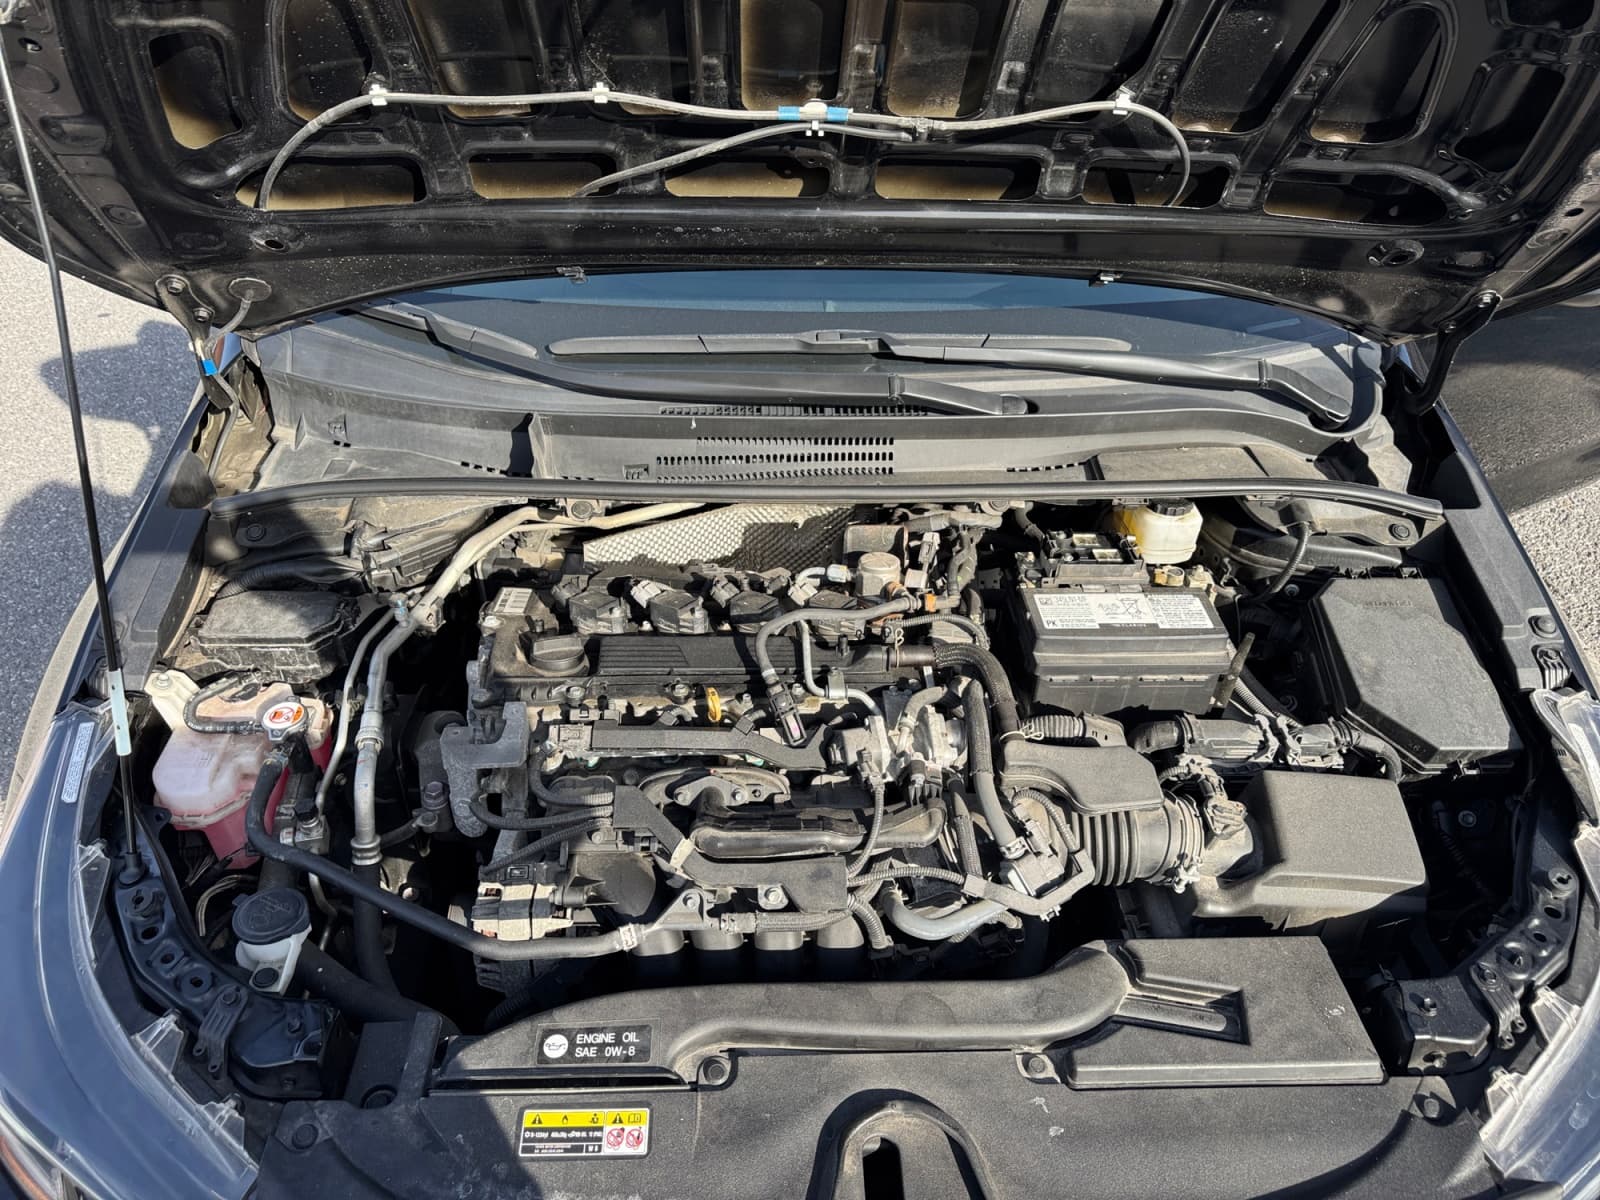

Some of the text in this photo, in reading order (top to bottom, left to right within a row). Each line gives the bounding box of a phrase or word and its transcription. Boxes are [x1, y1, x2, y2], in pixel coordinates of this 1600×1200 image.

[575, 1032, 640, 1044] ENGINE OIL
[575, 1046, 636, 1057] SAE 0W-8
